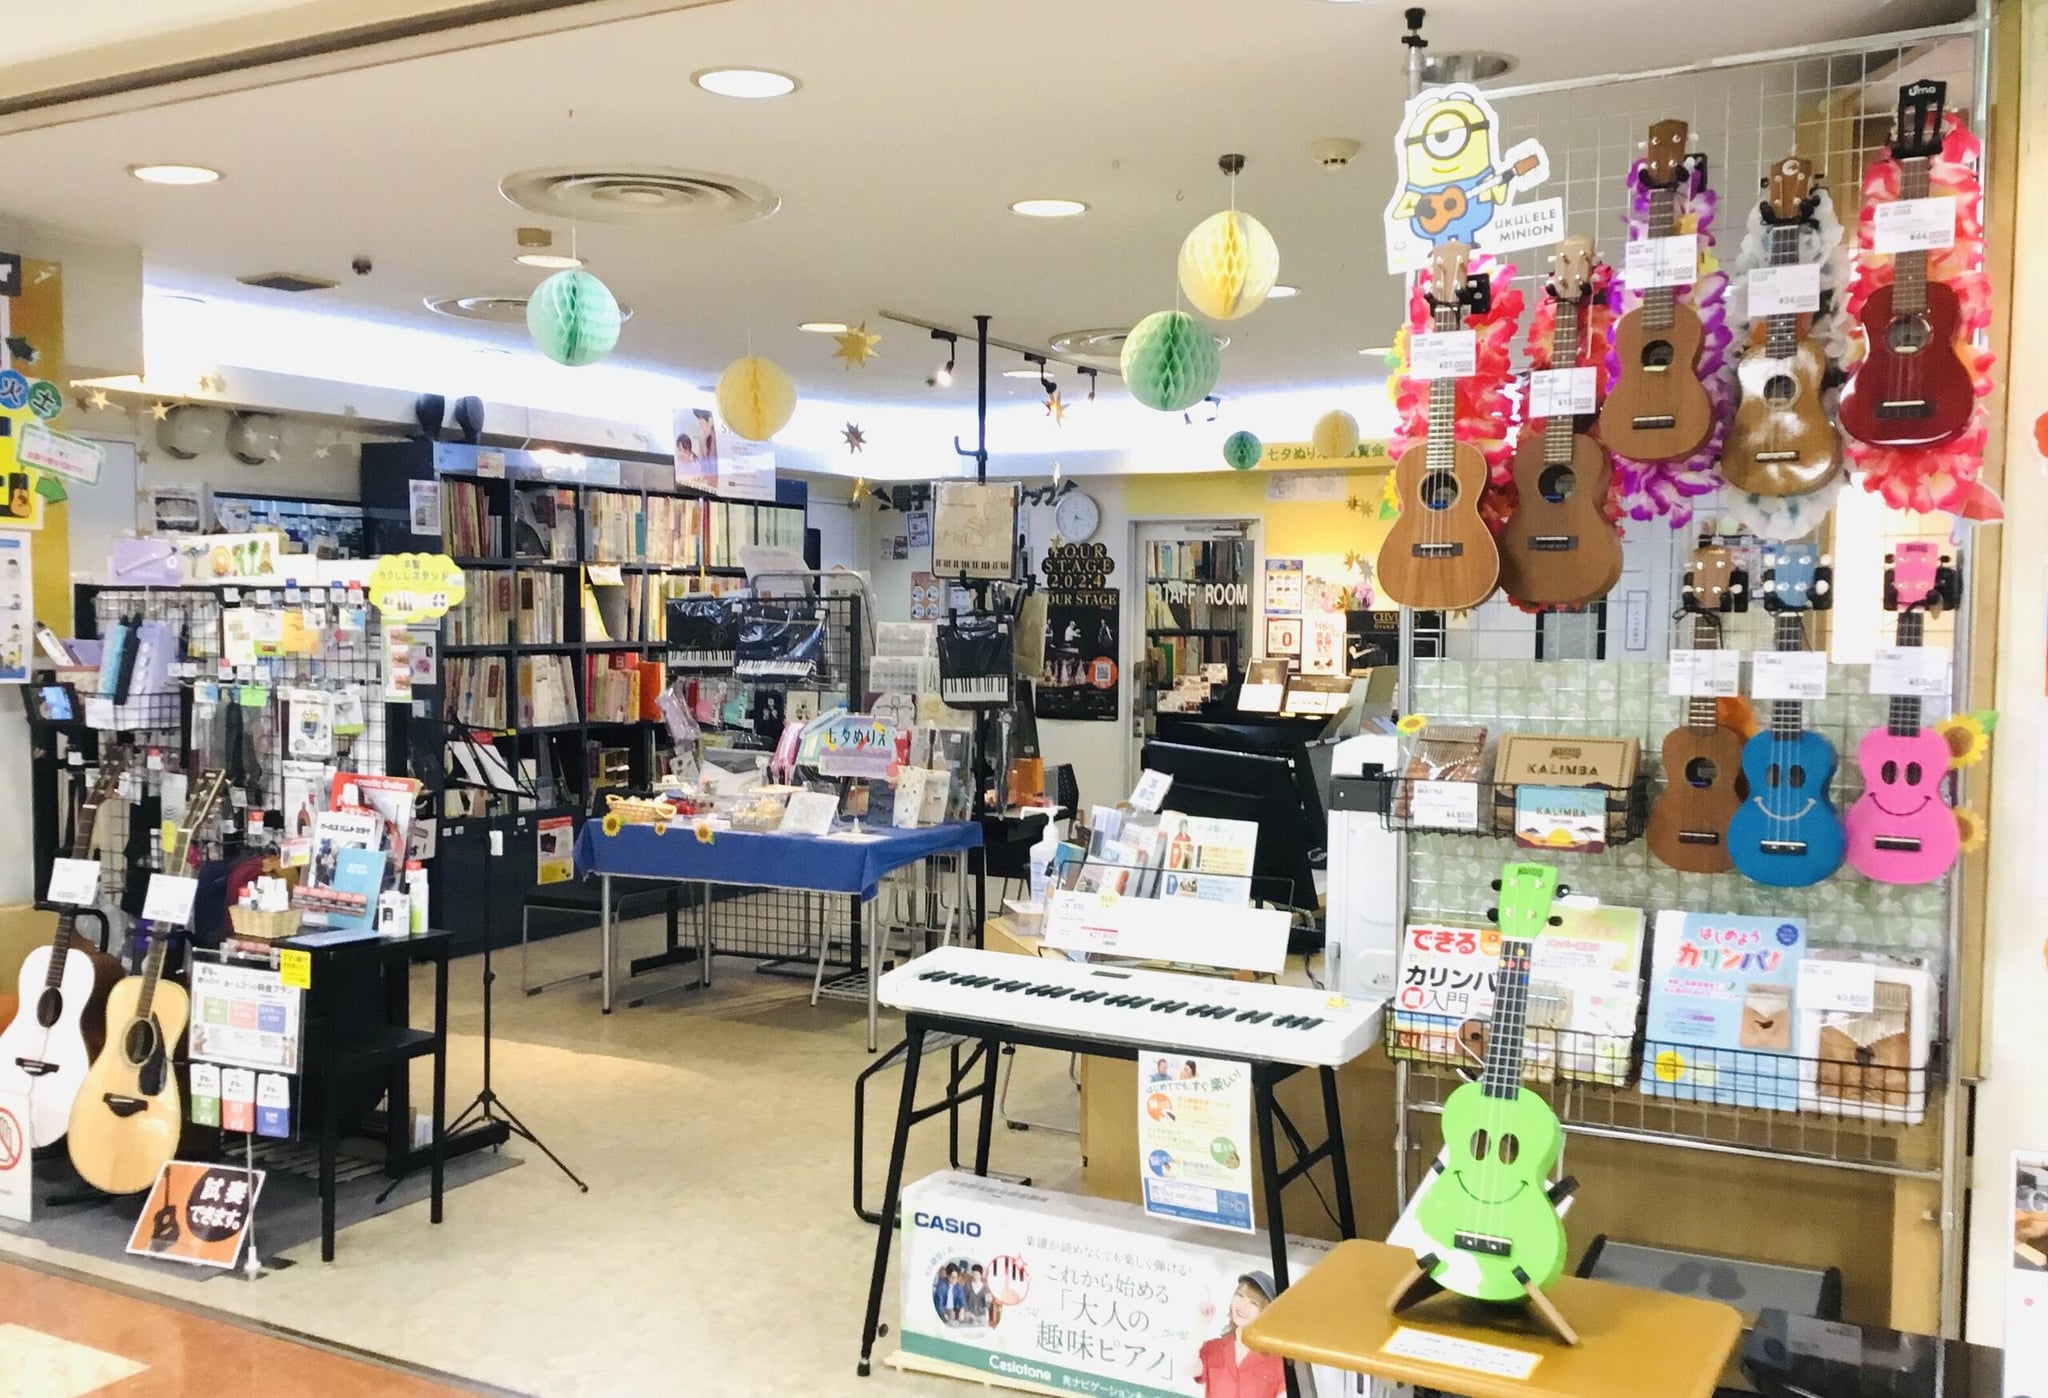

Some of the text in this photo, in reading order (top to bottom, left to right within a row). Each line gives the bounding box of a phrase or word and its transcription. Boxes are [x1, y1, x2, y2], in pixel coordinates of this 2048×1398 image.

[1494, 208, 1557, 229] UKULELE
[1500, 222, 1554, 242] MINION
[0, 377, 22, 406] 火
[32, 390, 54, 414] 土
[1044, 558, 1114, 573] STAGE
[1050, 574, 1102, 588] 2024
[1076, 593, 1117, 606] STAGE
[1154, 583, 1248, 605] STAFF ROOM
[1527, 763, 1599, 776] KALIMBA
[1535, 806, 1588, 818] KALIMBA
[1411, 929, 1477, 955] できる
[1699, 926, 1762, 946] はじめよう
[200, 1176, 249, 1206] 試奏
[189, 1205, 242, 1231] できます。
[914, 1211, 982, 1238] CASIO
[1046, 1263, 1170, 1304] これから始める
[1060, 1287, 1150, 1333] 「大人の
[1036, 1319, 1174, 1382] 趣味ピアノ」
[988, 1353, 1053, 1382] Casiotone
